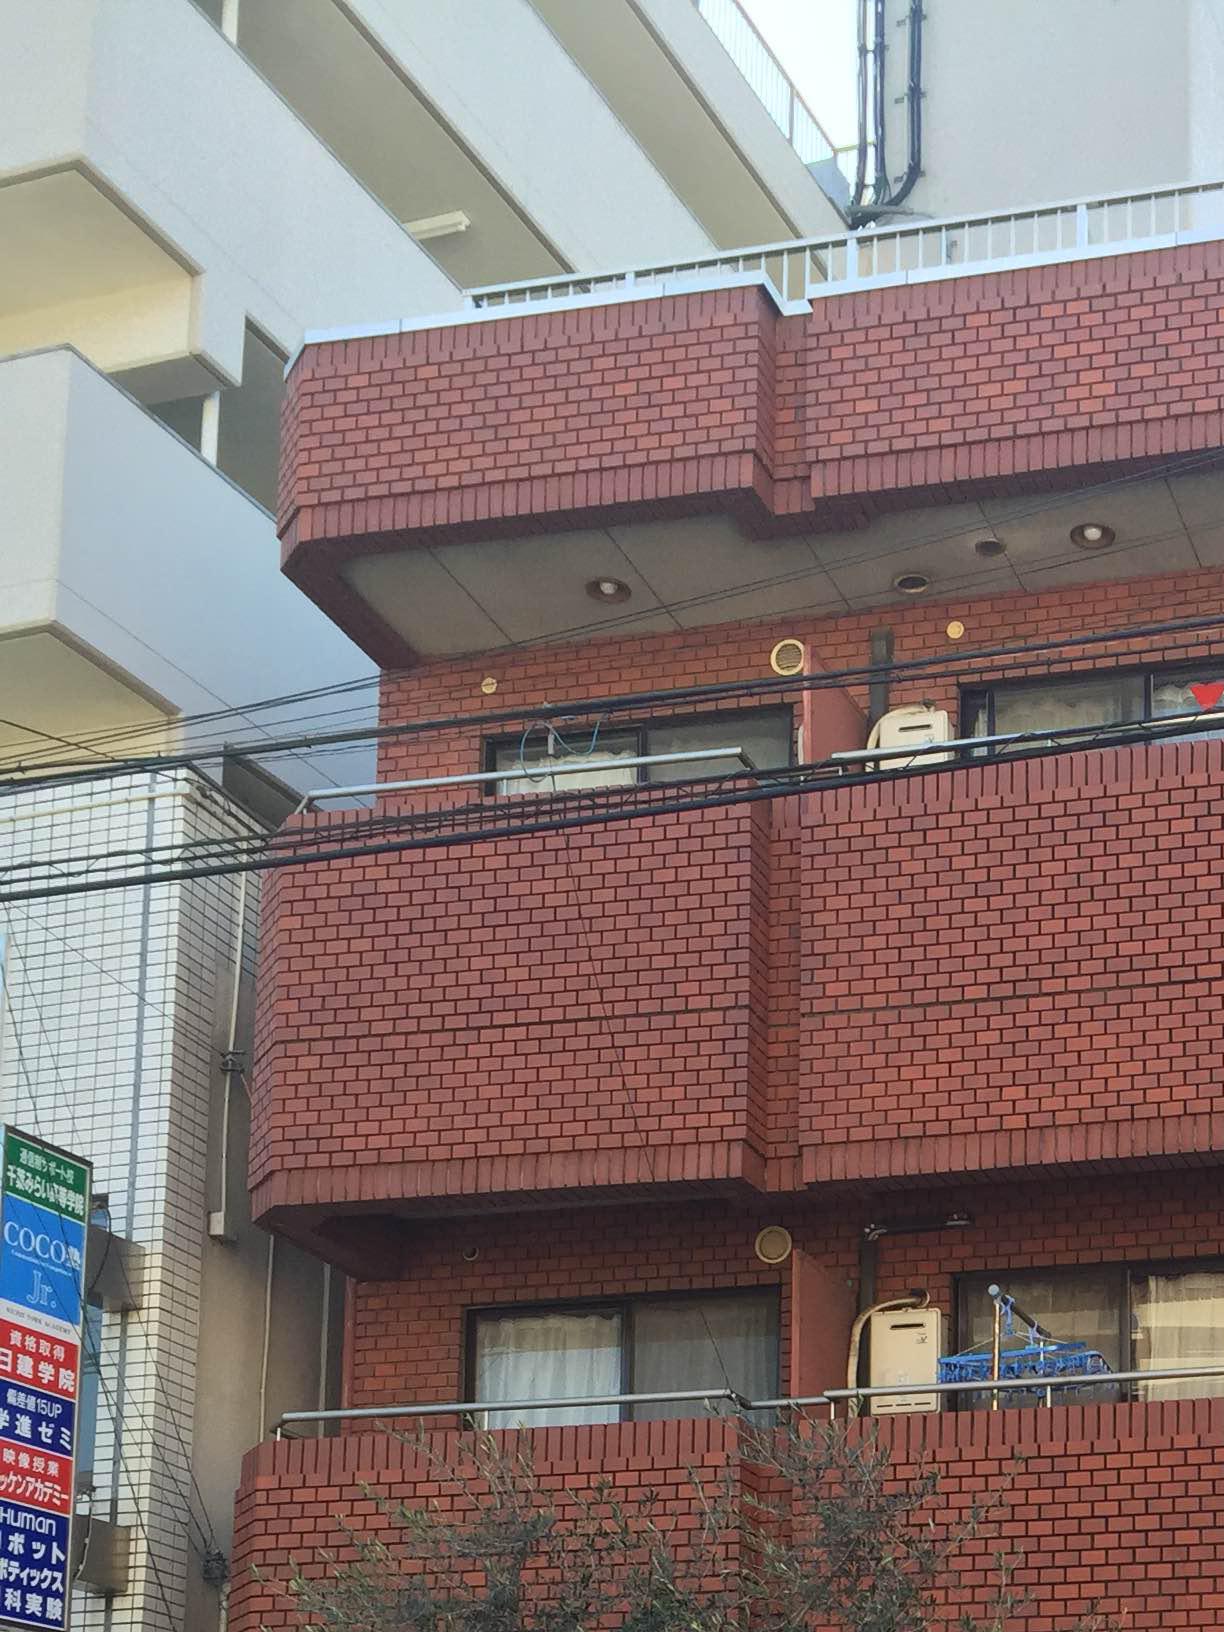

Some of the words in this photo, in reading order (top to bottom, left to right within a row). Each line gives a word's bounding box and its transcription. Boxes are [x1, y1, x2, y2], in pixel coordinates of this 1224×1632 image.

[26, 1270, 57, 1309] Jr.
[9, 1329, 65, 1362] 資格取得
[0, 1347, 75, 1392] 日建学院
[6, 1388, 62, 1418] 偏差値15UP
[3, 1448, 59, 1478] 映像授業
[0, 1506, 56, 1536] Human
[0, 1530, 66, 1565] ボット
